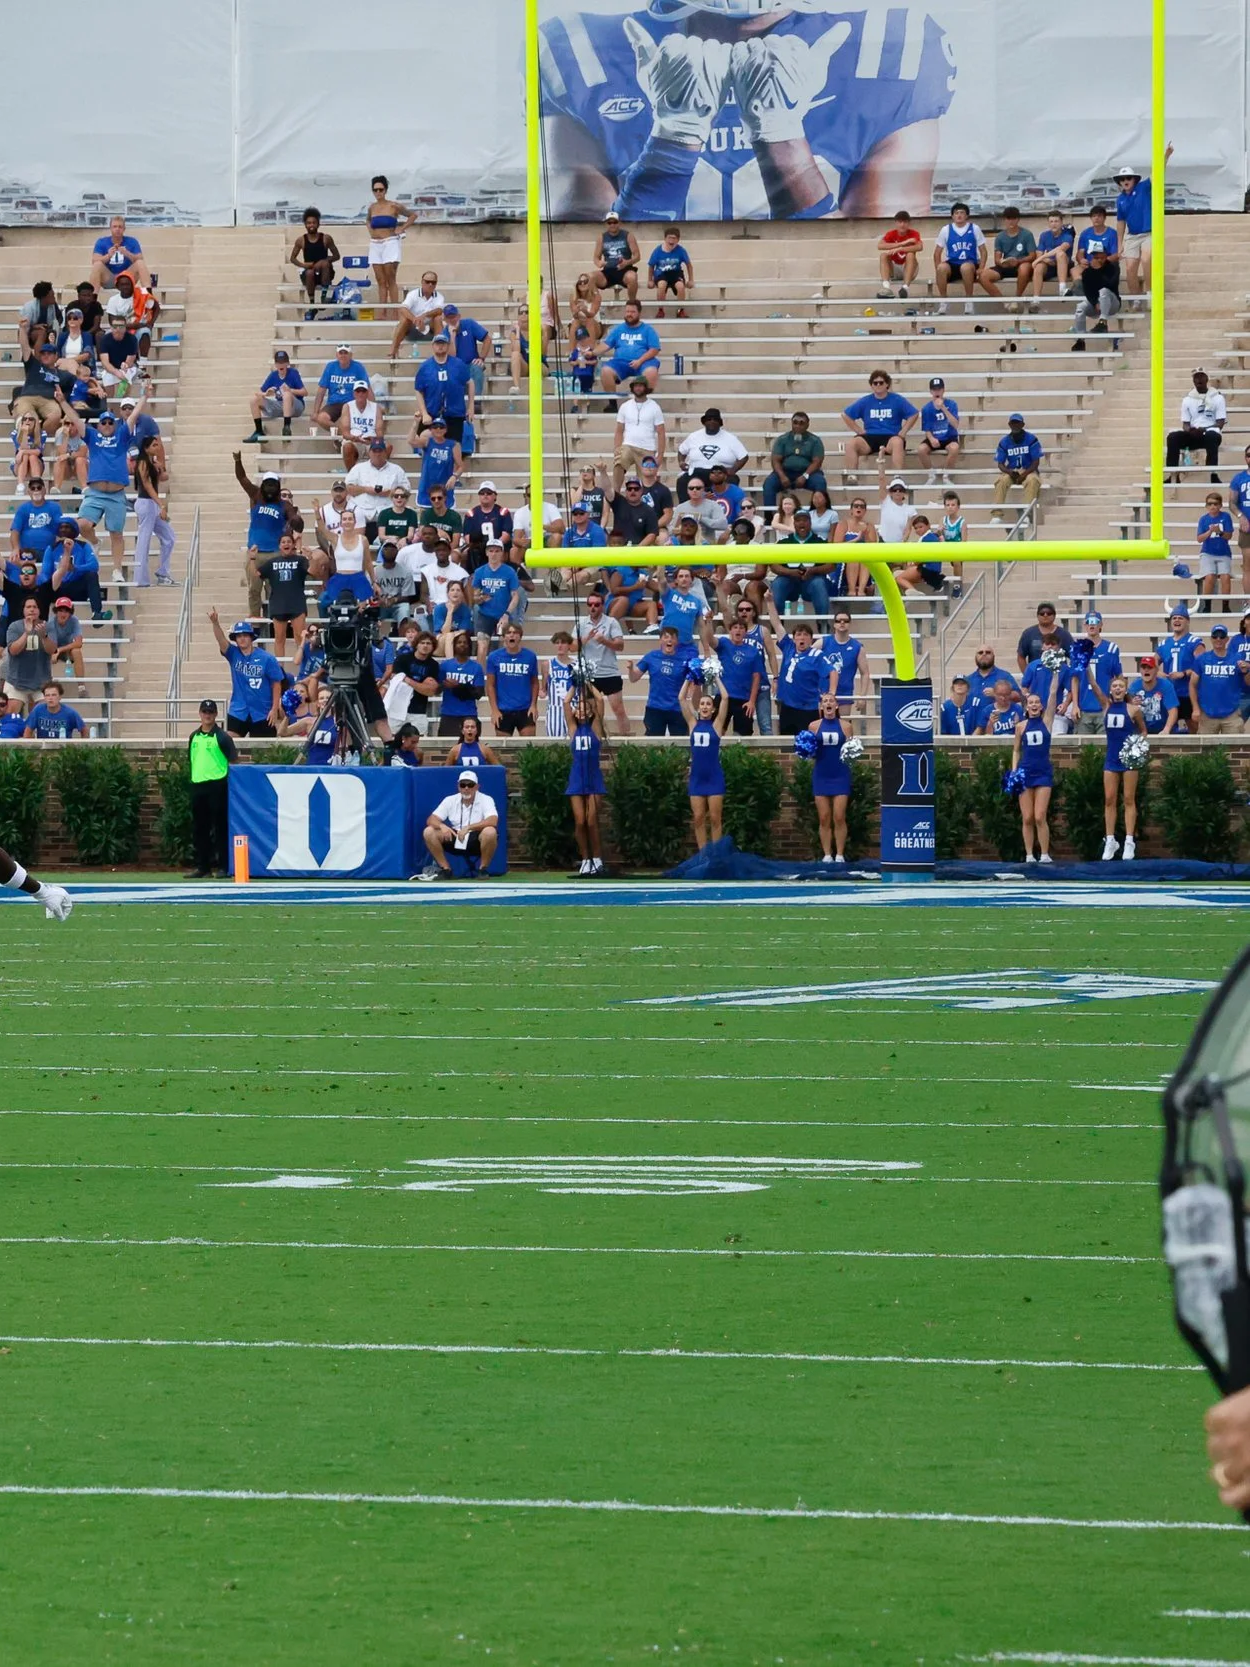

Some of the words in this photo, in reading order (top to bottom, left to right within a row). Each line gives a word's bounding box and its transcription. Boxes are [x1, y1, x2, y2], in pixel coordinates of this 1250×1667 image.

[604, 98, 642, 114] ACC
[330, 375, 356, 384] DUKE
[869, 408, 892, 419] BLUE
[257, 506, 280, 520] DUKE
[481, 522, 495, 539] 9
[272, 561, 299, 571] DUKE
[481, 579, 507, 588] DUKE
[1171, 652, 1179, 673] 1
[499, 663, 529, 675] DUKE
[1204, 664, 1236, 676] DUKE
[248, 679, 262, 689] 27
[912, 821, 931, 830] ACC
